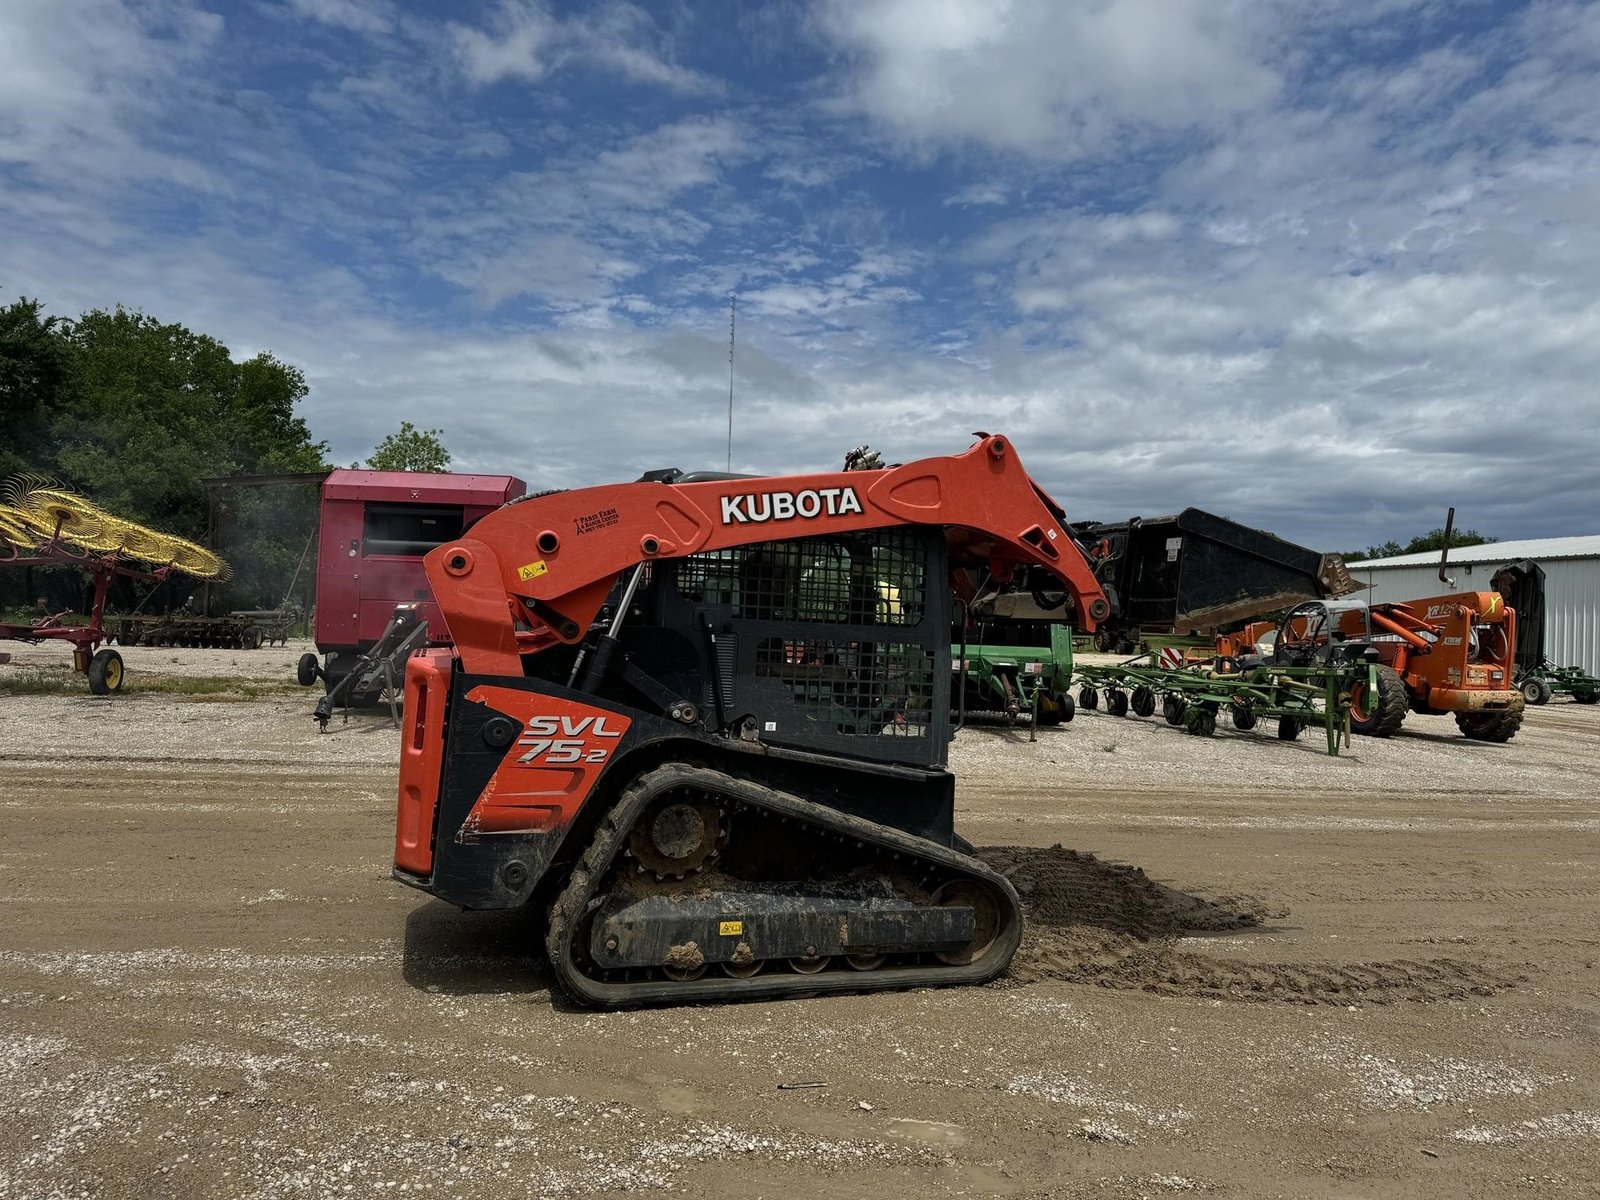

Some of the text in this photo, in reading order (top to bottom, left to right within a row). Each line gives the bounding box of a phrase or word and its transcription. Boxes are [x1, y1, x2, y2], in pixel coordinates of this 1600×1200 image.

[580, 508, 616, 523] PARIS FARM
[720, 487, 863, 524] KUBOTA
[523, 715, 621, 737] SVL
[516, 739, 608, 763] 75-2
